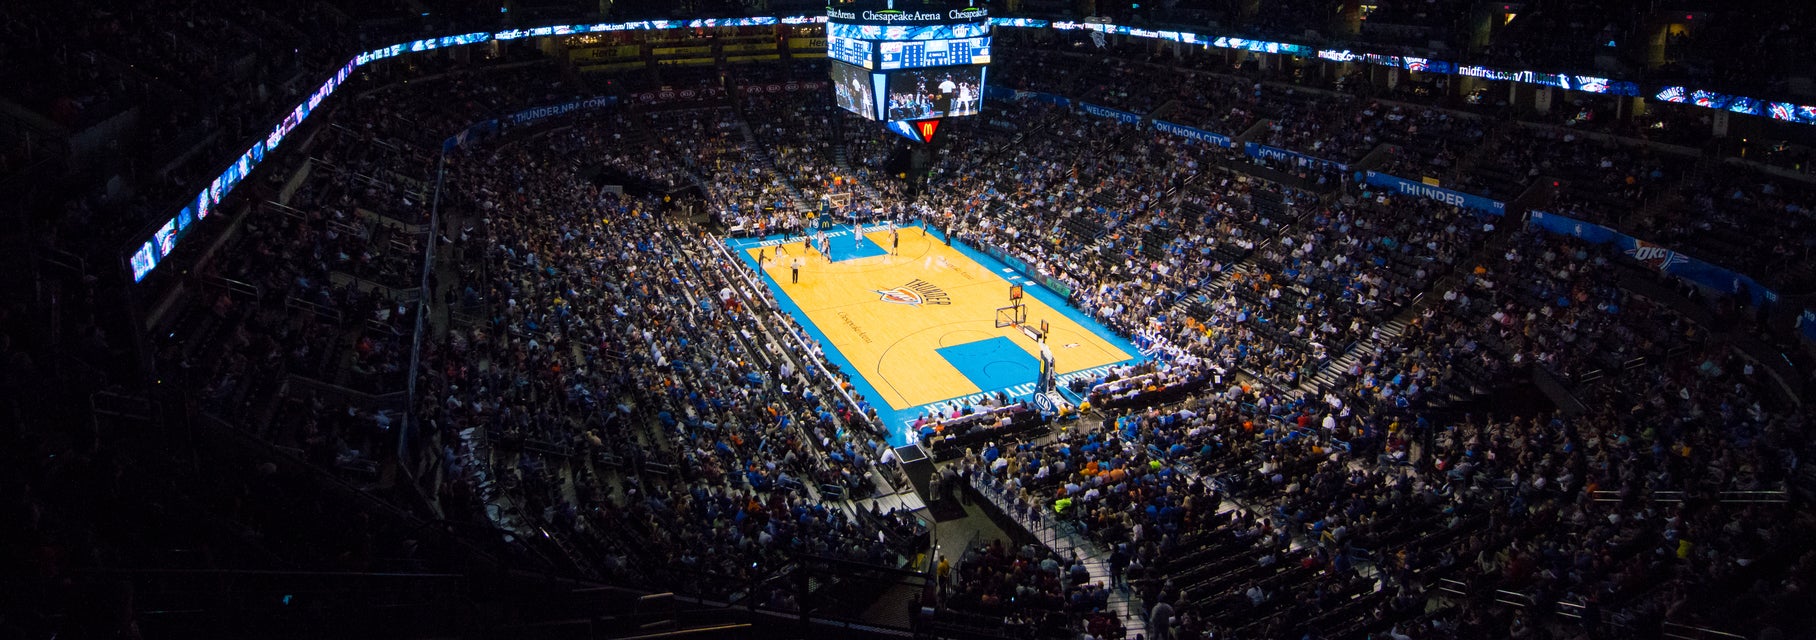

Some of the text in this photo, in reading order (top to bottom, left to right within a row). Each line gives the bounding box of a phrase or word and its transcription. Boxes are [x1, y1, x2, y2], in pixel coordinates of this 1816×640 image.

[862, 10, 941, 24] Chesapeake Arena
[1086, 105, 1132, 123] WELCOME TO
[1204, 134, 1223, 146] CITY
[1399, 181, 1465, 207] THUNDER
[1493, 201, 1505, 209] 117
[1531, 210, 1543, 219] 118
[1635, 246, 1666, 261] OKC
[905, 278, 952, 305] THUNDER
